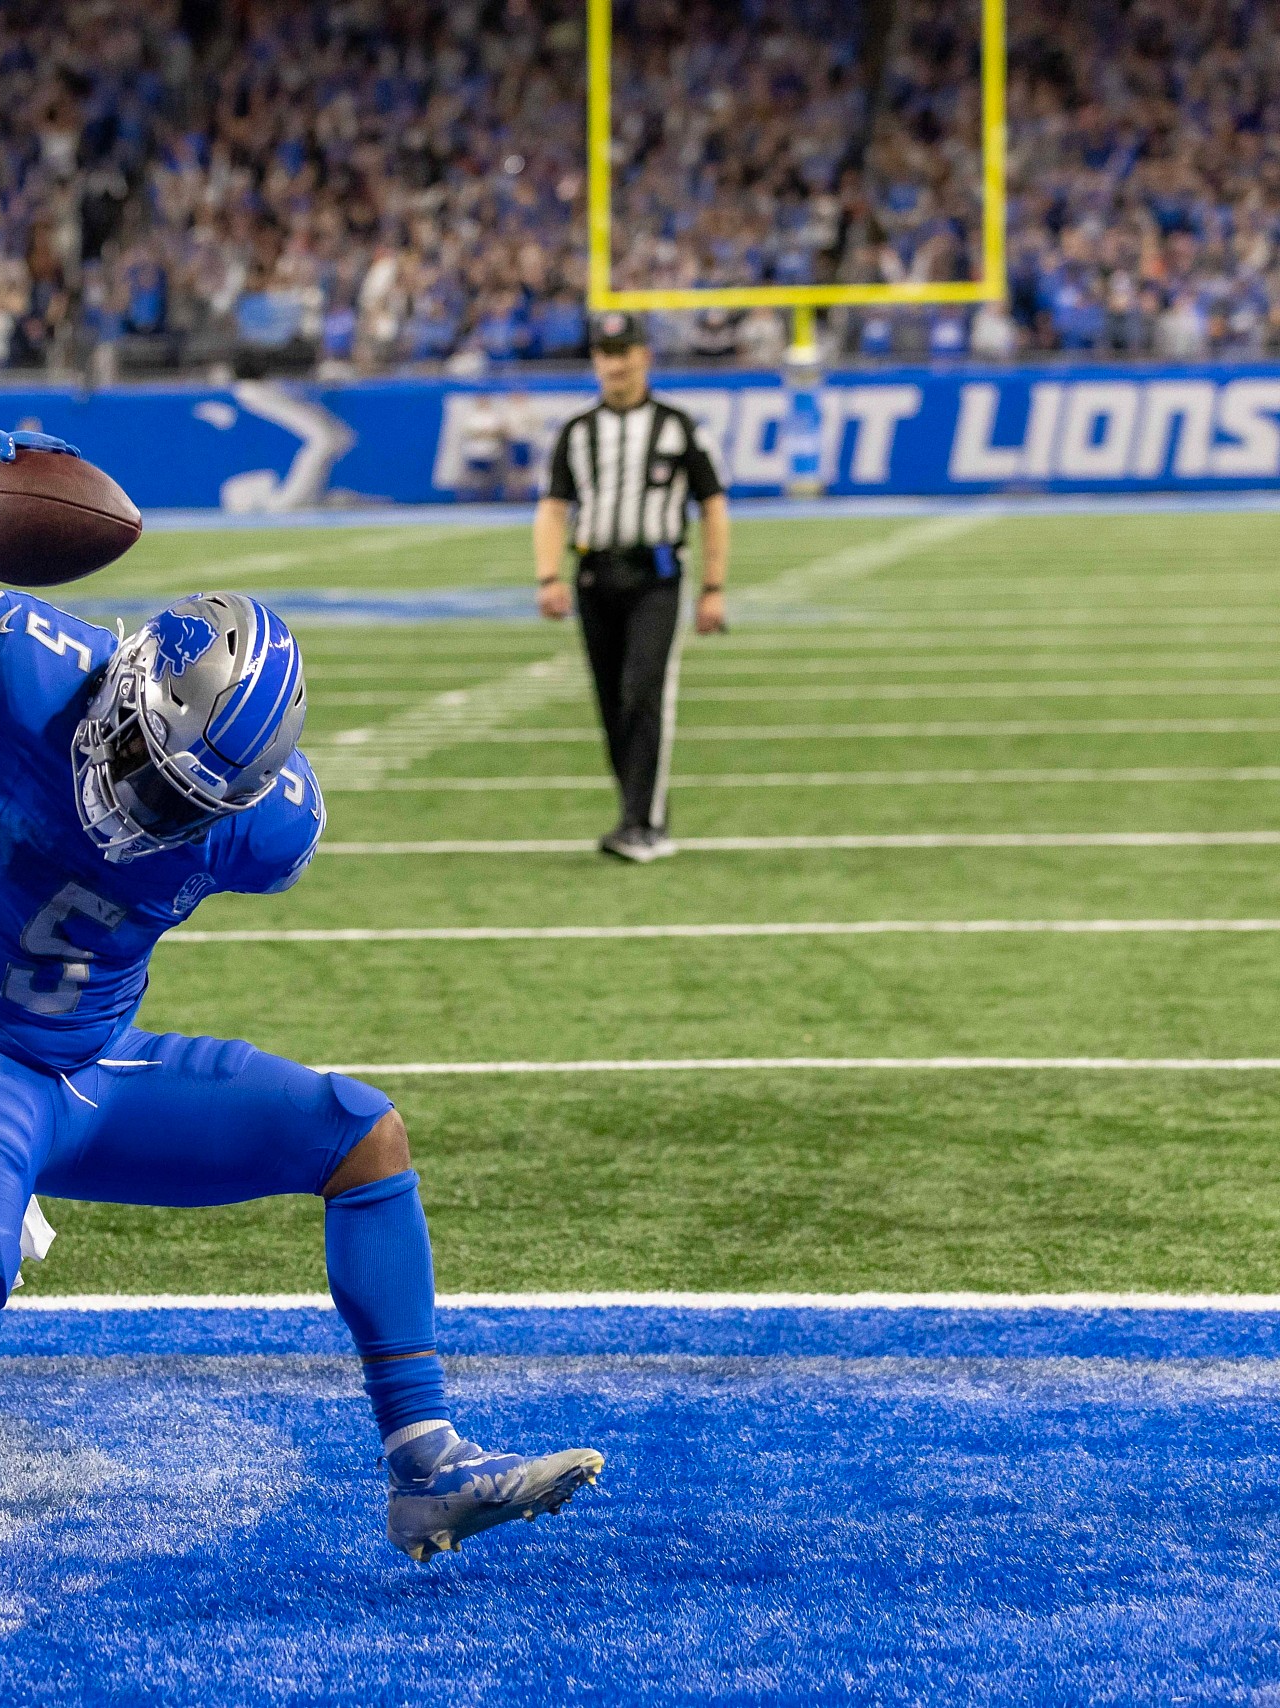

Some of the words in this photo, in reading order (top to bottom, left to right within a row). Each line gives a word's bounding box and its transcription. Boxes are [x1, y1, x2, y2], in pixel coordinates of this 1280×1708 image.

[947, 377, 1280, 482] LIONS
[26, 611, 92, 673] 5
[1, 881, 127, 1017] 5
